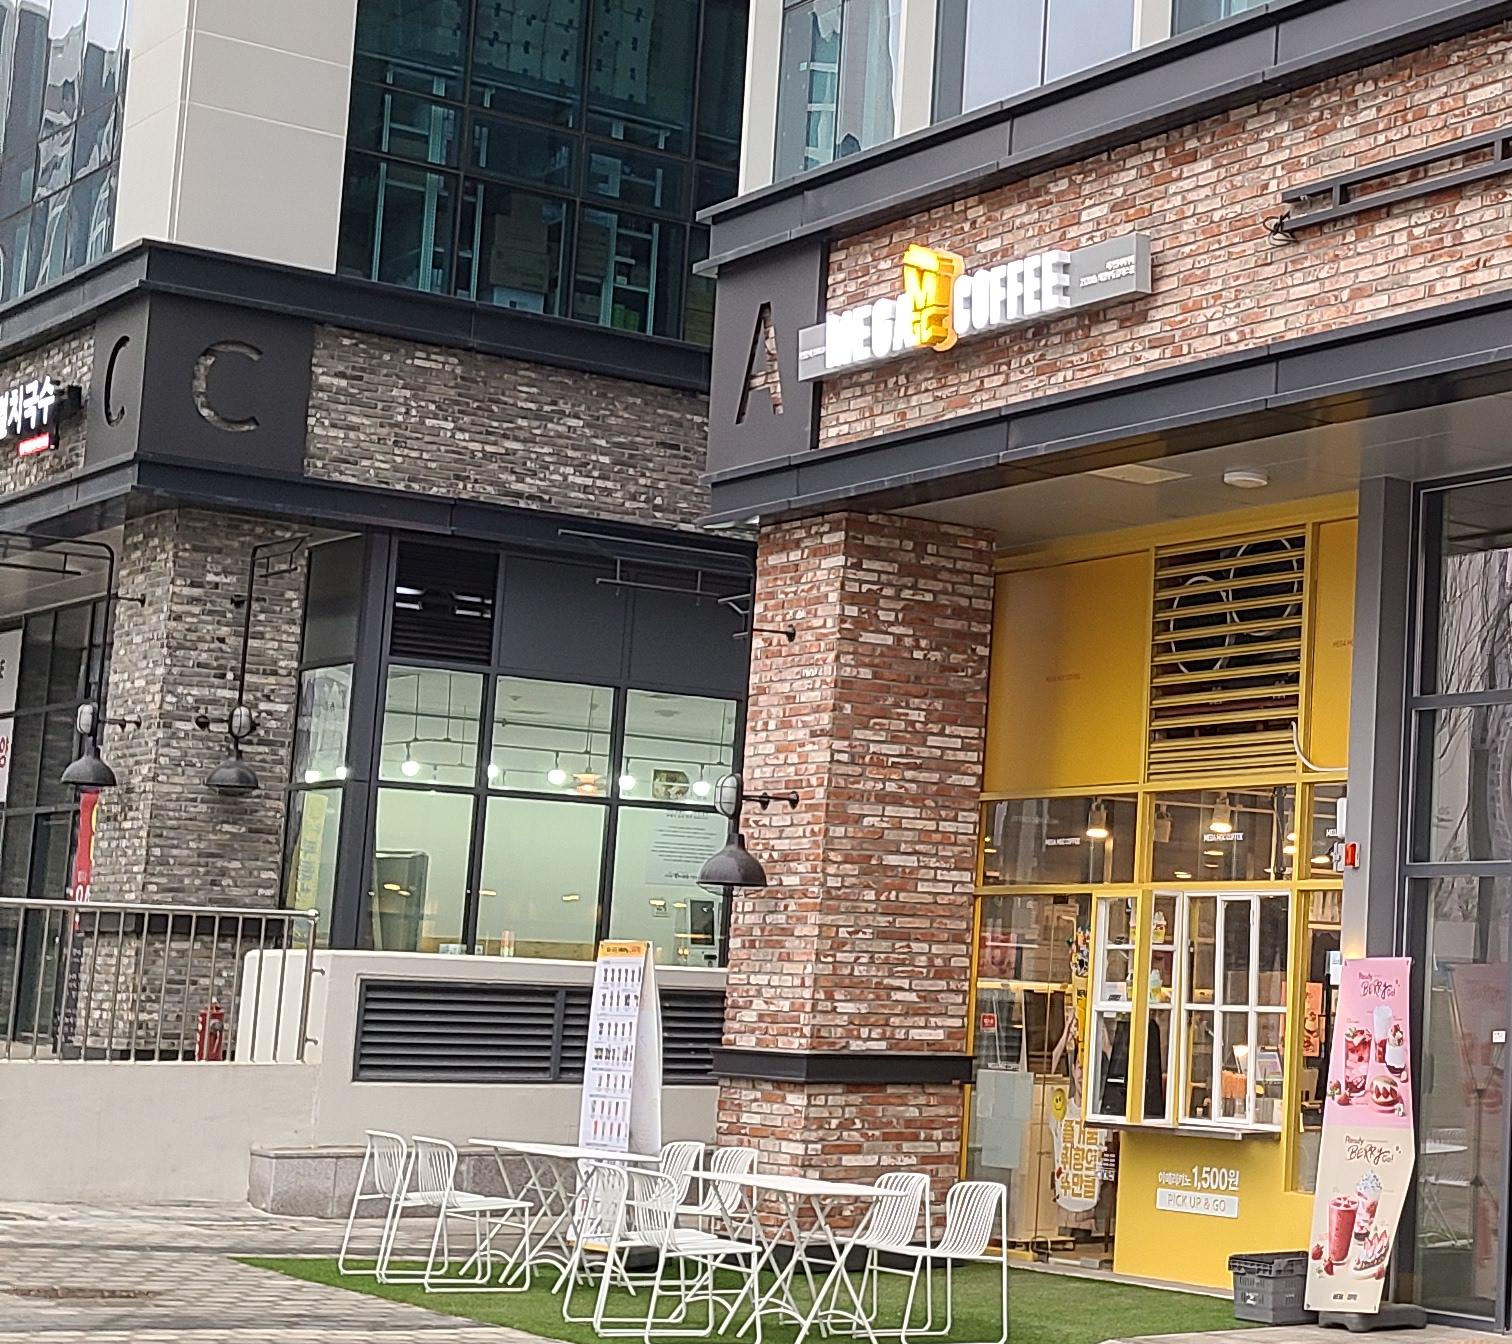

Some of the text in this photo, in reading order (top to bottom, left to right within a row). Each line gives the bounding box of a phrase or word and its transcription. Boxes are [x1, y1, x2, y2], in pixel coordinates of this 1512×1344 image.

[954, 250, 1070, 336] COFFEE
[1192, 1165, 1239, 1191] 1,500원
[1167, 1193, 1227, 1212] PICK UP & GO
